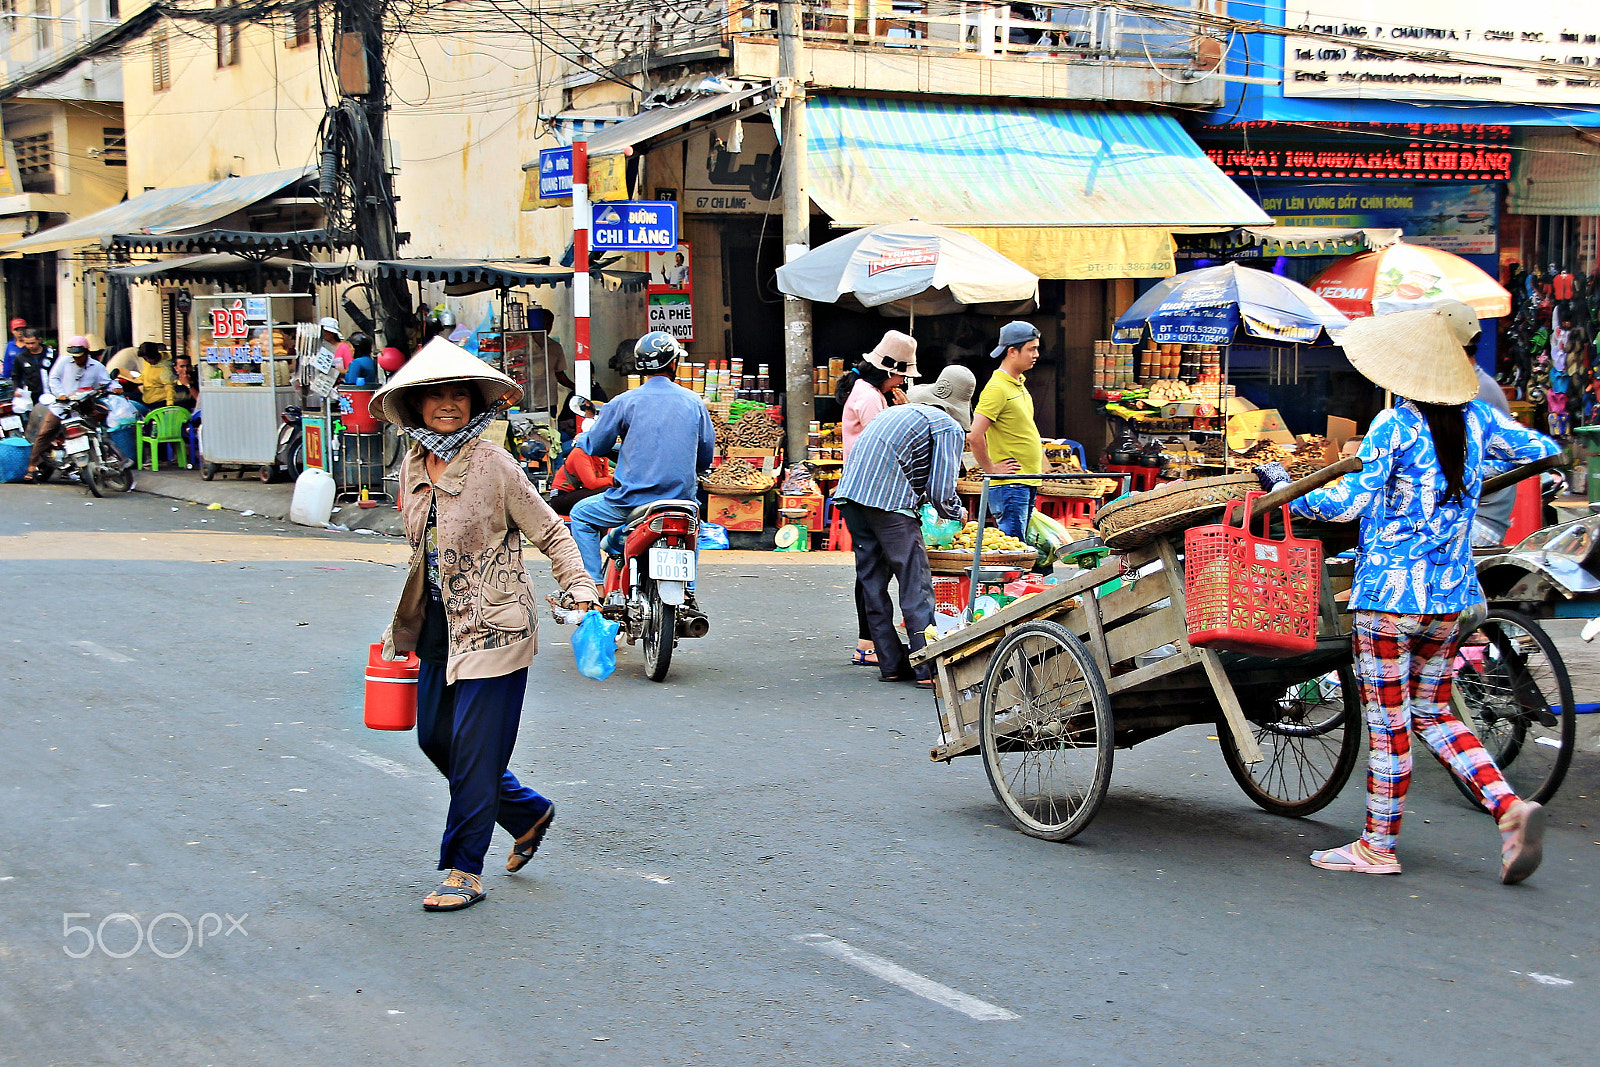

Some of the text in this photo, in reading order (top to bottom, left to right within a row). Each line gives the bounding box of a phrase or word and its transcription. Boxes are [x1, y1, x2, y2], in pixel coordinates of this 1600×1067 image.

[1423, 151, 1459, 170] KHI
[660, 192, 672, 201] 67
[696, 197, 709, 208] 67
[711, 197, 724, 208] CHI
[1263, 198, 1283, 210] BAY
[596, 226, 670, 245] CHI LĂNG
[887, 248, 923, 259] TRUNG
[1315, 286, 1368, 300] VEDAN
[650, 306, 692, 321] CÀ PHÊ
[672, 324, 693, 339] NGỌT
[1179, 325, 1228, 335] 076.532570
[656, 564, 689, 579] 0003
